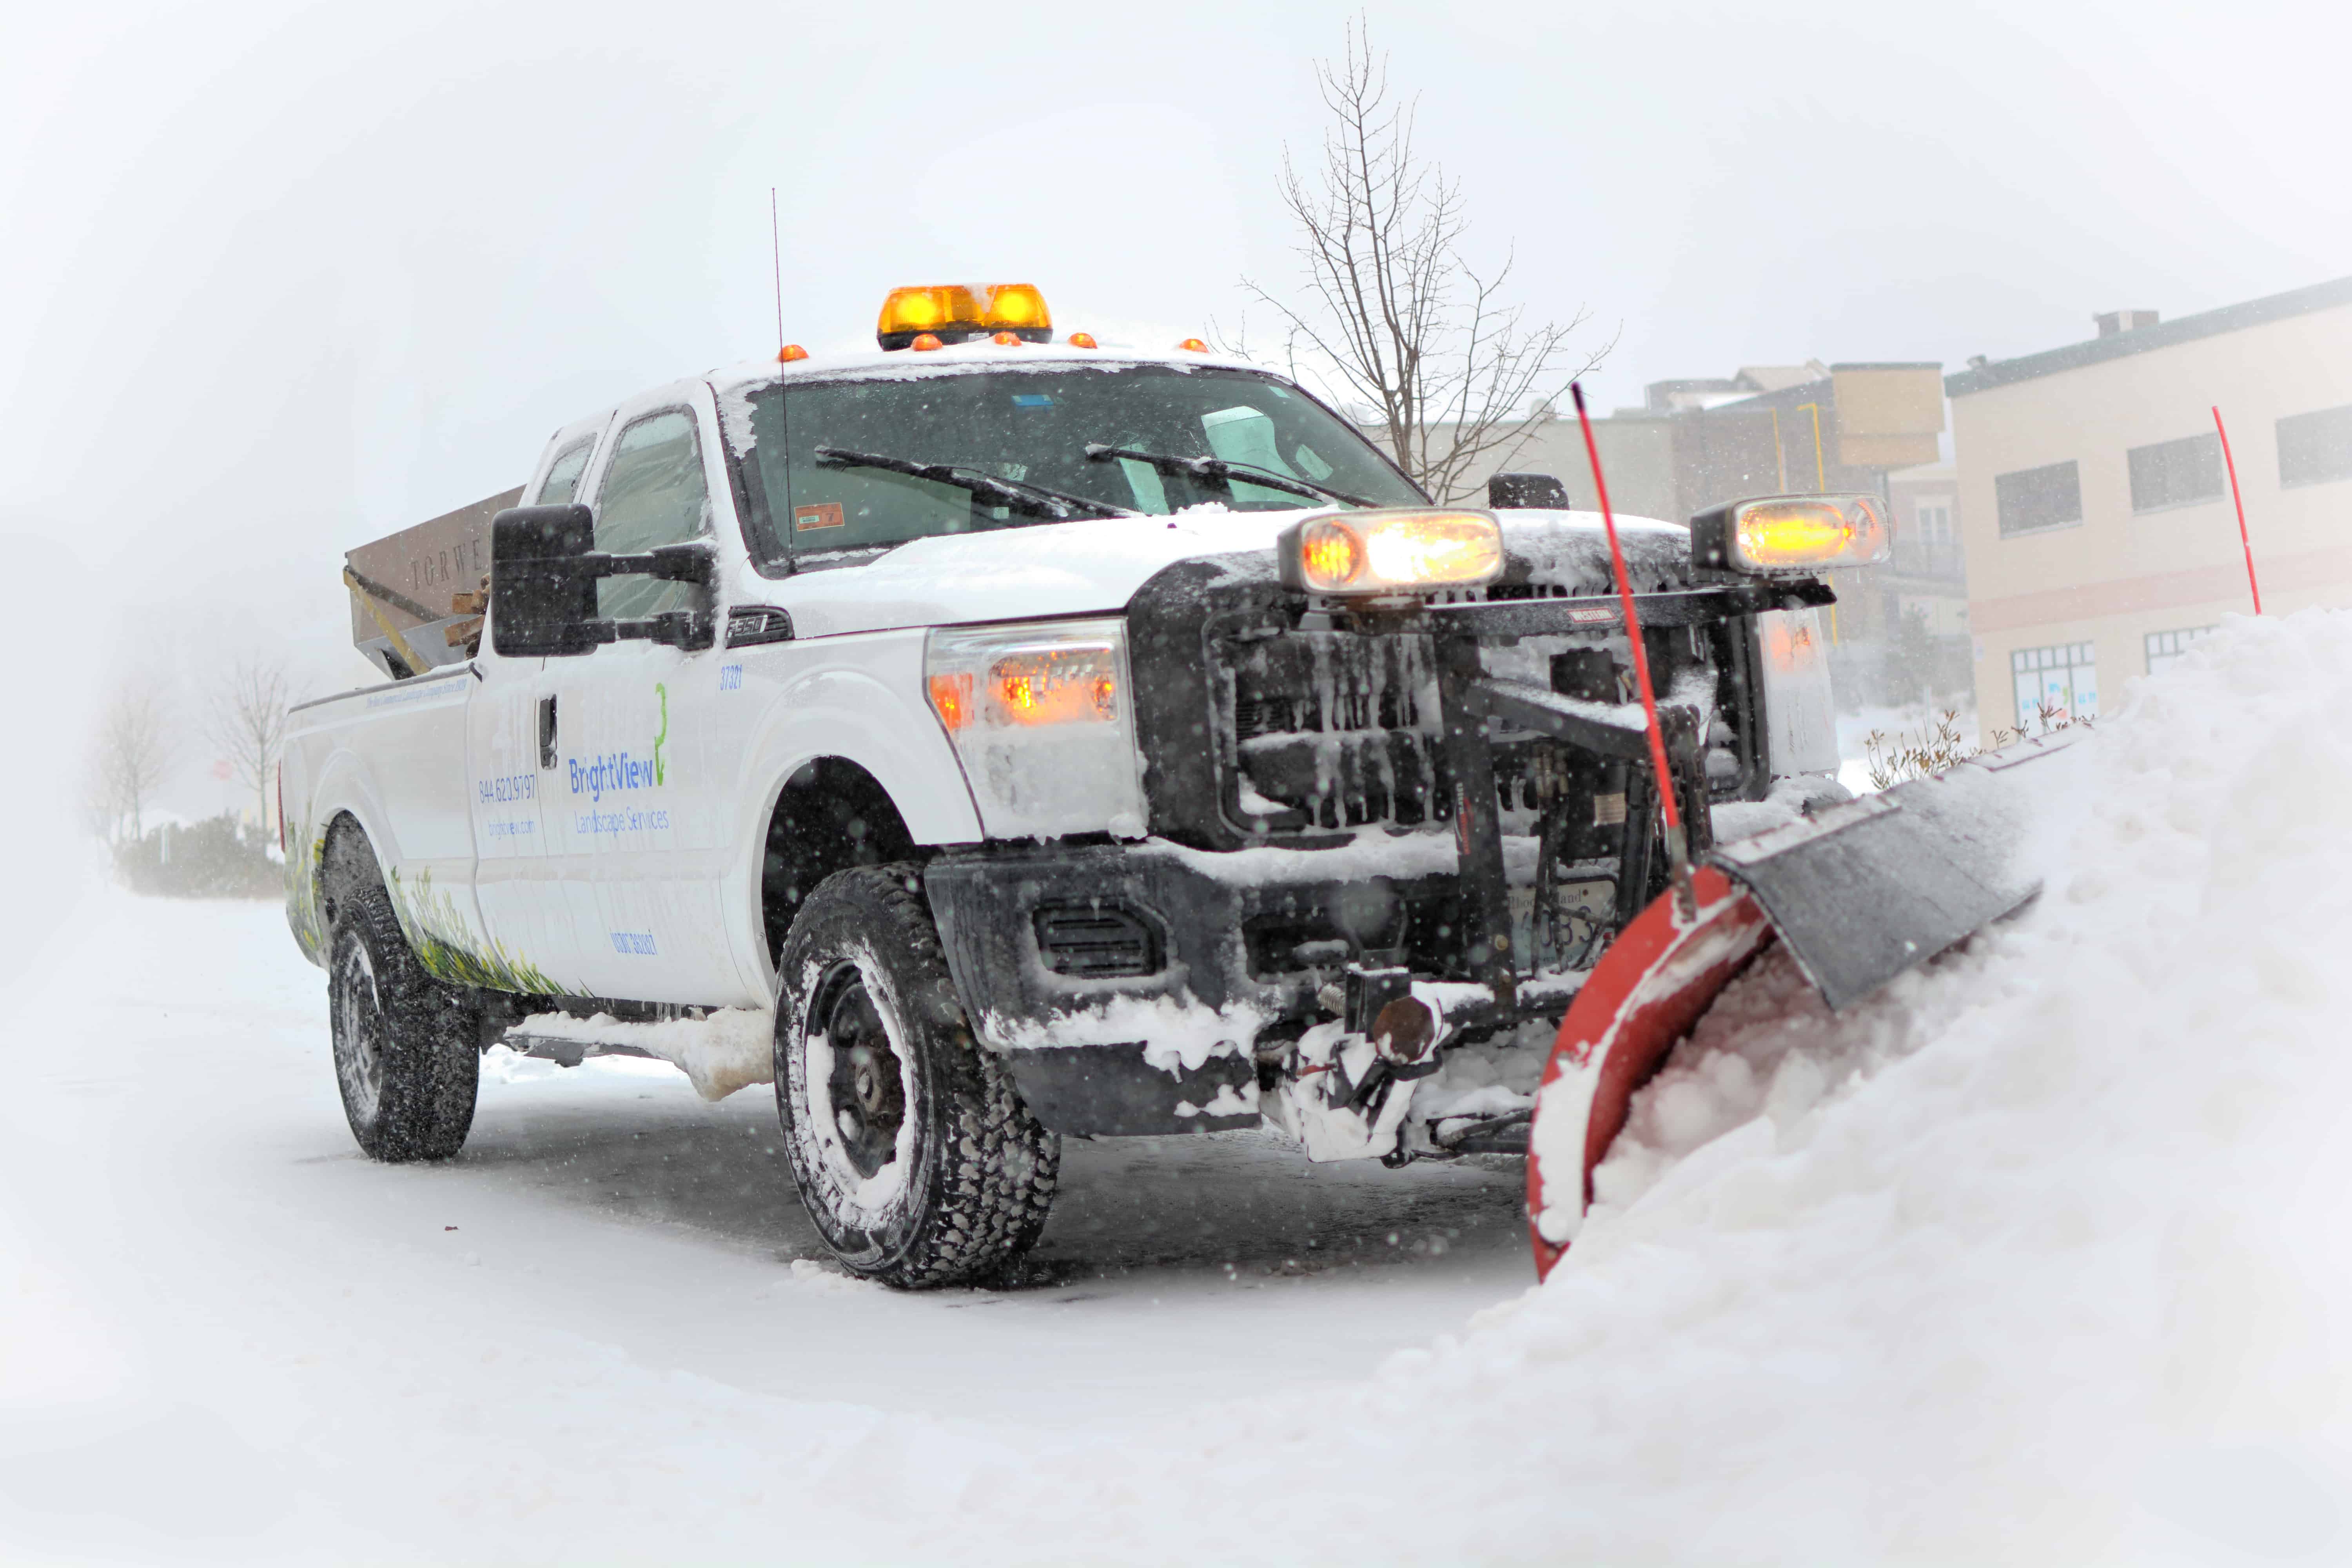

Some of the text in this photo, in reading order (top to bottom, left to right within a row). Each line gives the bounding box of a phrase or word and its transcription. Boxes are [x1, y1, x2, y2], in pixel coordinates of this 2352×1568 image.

[412, 535, 490, 590] TORWE
[1570, 610, 1612, 621] WESTERN
[720, 664, 742, 691] 37321
[479, 774, 535, 804] 844.620.9797
[569, 752, 653, 802] BrightView
[574, 806, 669, 838] Landscape Services
